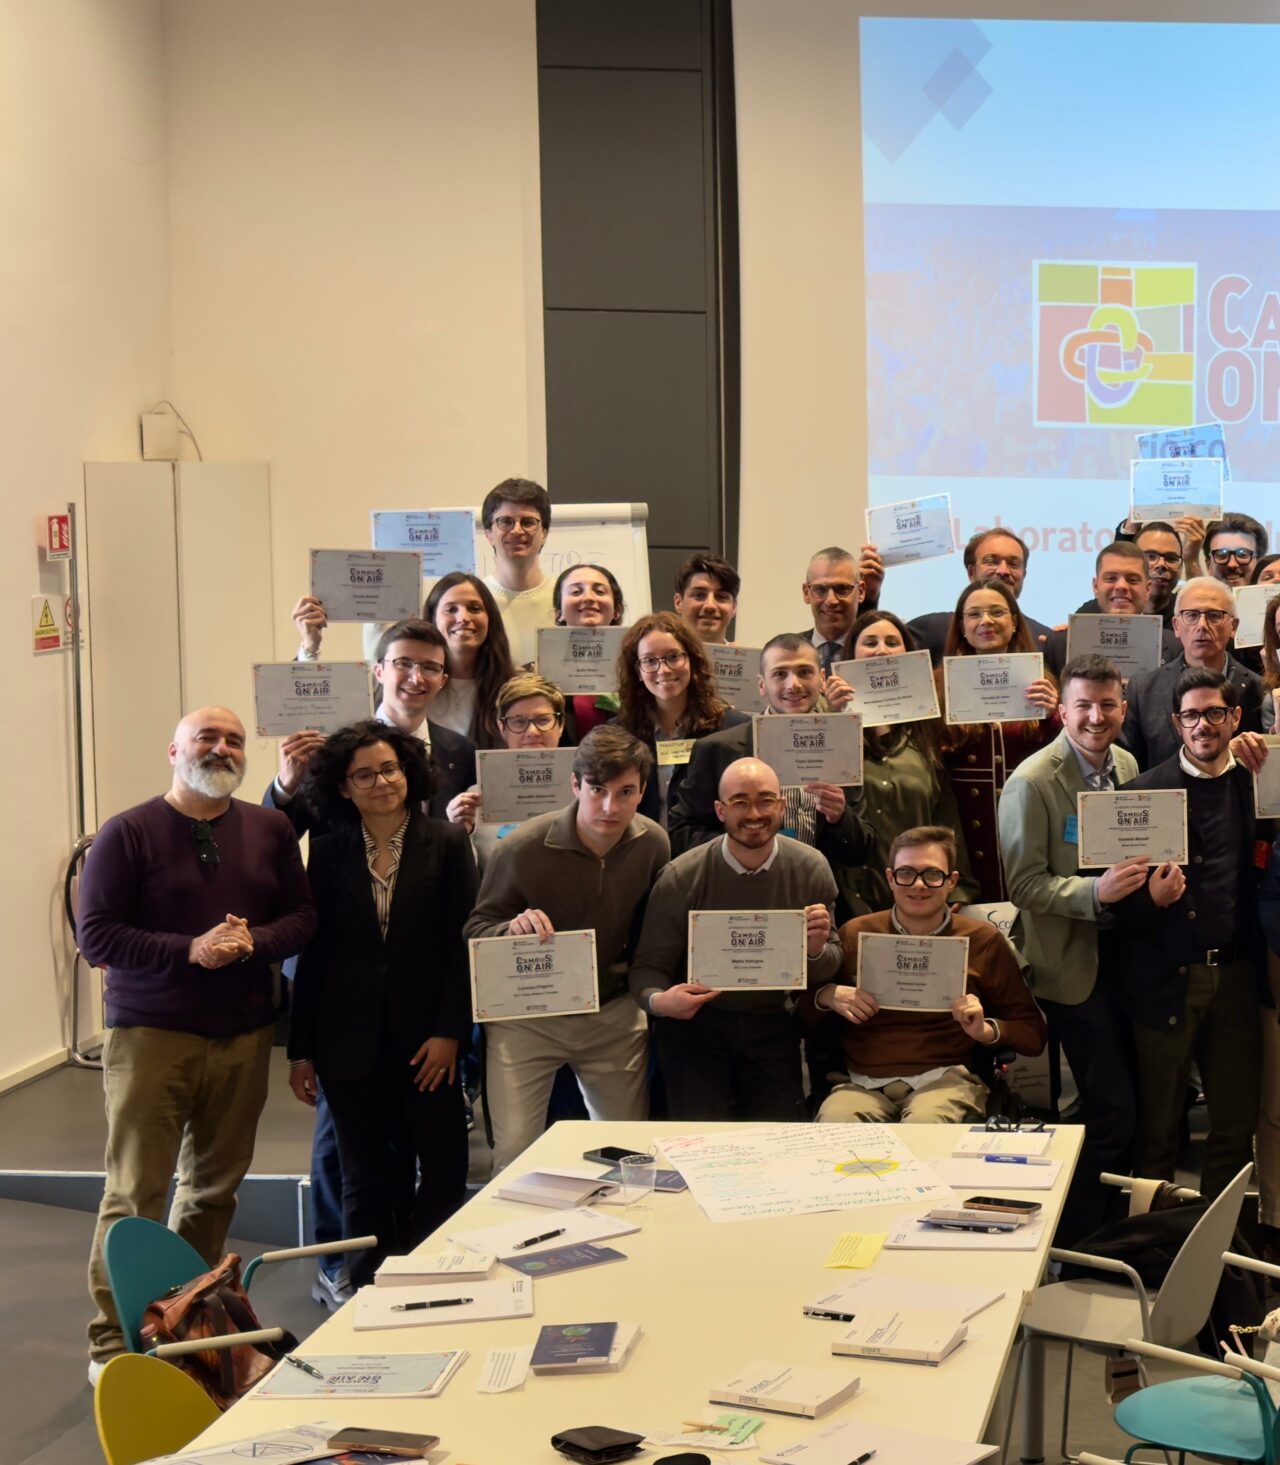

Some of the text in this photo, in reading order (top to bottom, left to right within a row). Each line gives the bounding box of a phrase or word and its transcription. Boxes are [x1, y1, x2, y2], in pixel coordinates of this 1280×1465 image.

[909, 520, 921, 528] AIR
[349, 568, 382, 576] CAMPUS
[349, 575, 382, 583] ON AIR
[1100, 637, 1128, 645] ON AIR
[572, 650, 602, 658] ON AIR
[980, 671, 1009, 679] CAMPUS
[294, 680, 329, 688] CAMPUS
[870, 678, 899, 689] ON AIR
[980, 678, 992, 686] ON
[295, 687, 330, 696] ON AIR
[793, 732, 825, 740] CAMPUS
[793, 739, 825, 748] ON AIR
[518, 767, 553, 775] CAMPUS
[518, 774, 553, 783] ON AIR
[1117, 810, 1150, 818] CAMPUS
[1117, 817, 1150, 825] ON AIR
[730, 930, 765, 939] CAMPUS
[731, 938, 765, 947] ON AIR
[516, 954, 553, 965] CAMPUS
[896, 954, 929, 962] CAMPUS
[516, 962, 553, 973] ON AIR
[896, 961, 929, 970] ON AIR
